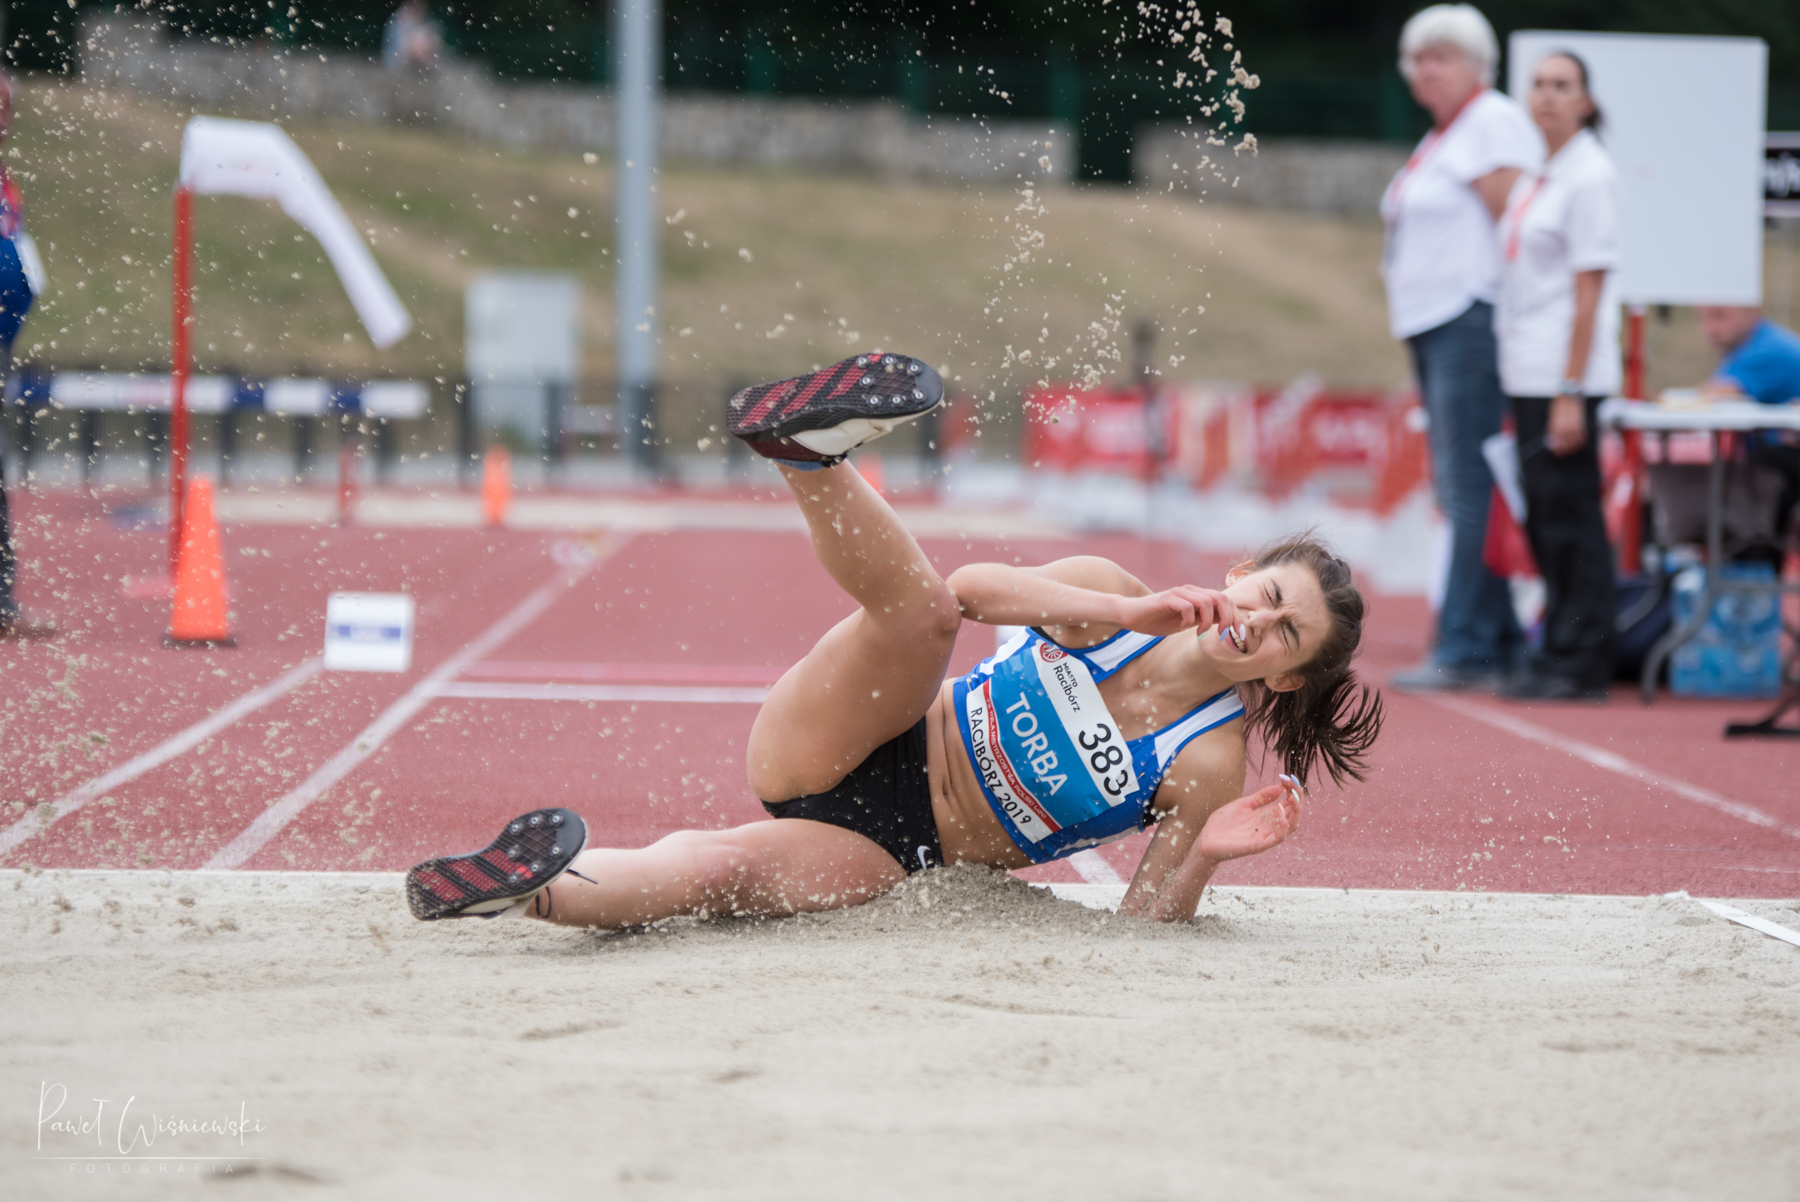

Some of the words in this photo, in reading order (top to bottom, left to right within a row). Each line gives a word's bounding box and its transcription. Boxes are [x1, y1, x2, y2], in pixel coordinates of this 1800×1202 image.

[1053, 665, 1081, 713] Racibórz
[1062, 662, 1078, 688] MIASTO
[970, 707, 1003, 793] RACIBÓRZ
[996, 793, 1032, 825] 2019
[990, 731, 1016, 786] MISTRZOSTWA
[1013, 785, 1036, 808] POLSKI
[1033, 804, 1048, 819] U20
[1006, 691, 1068, 796] TORBA
[1078, 723, 1129, 797] 383
